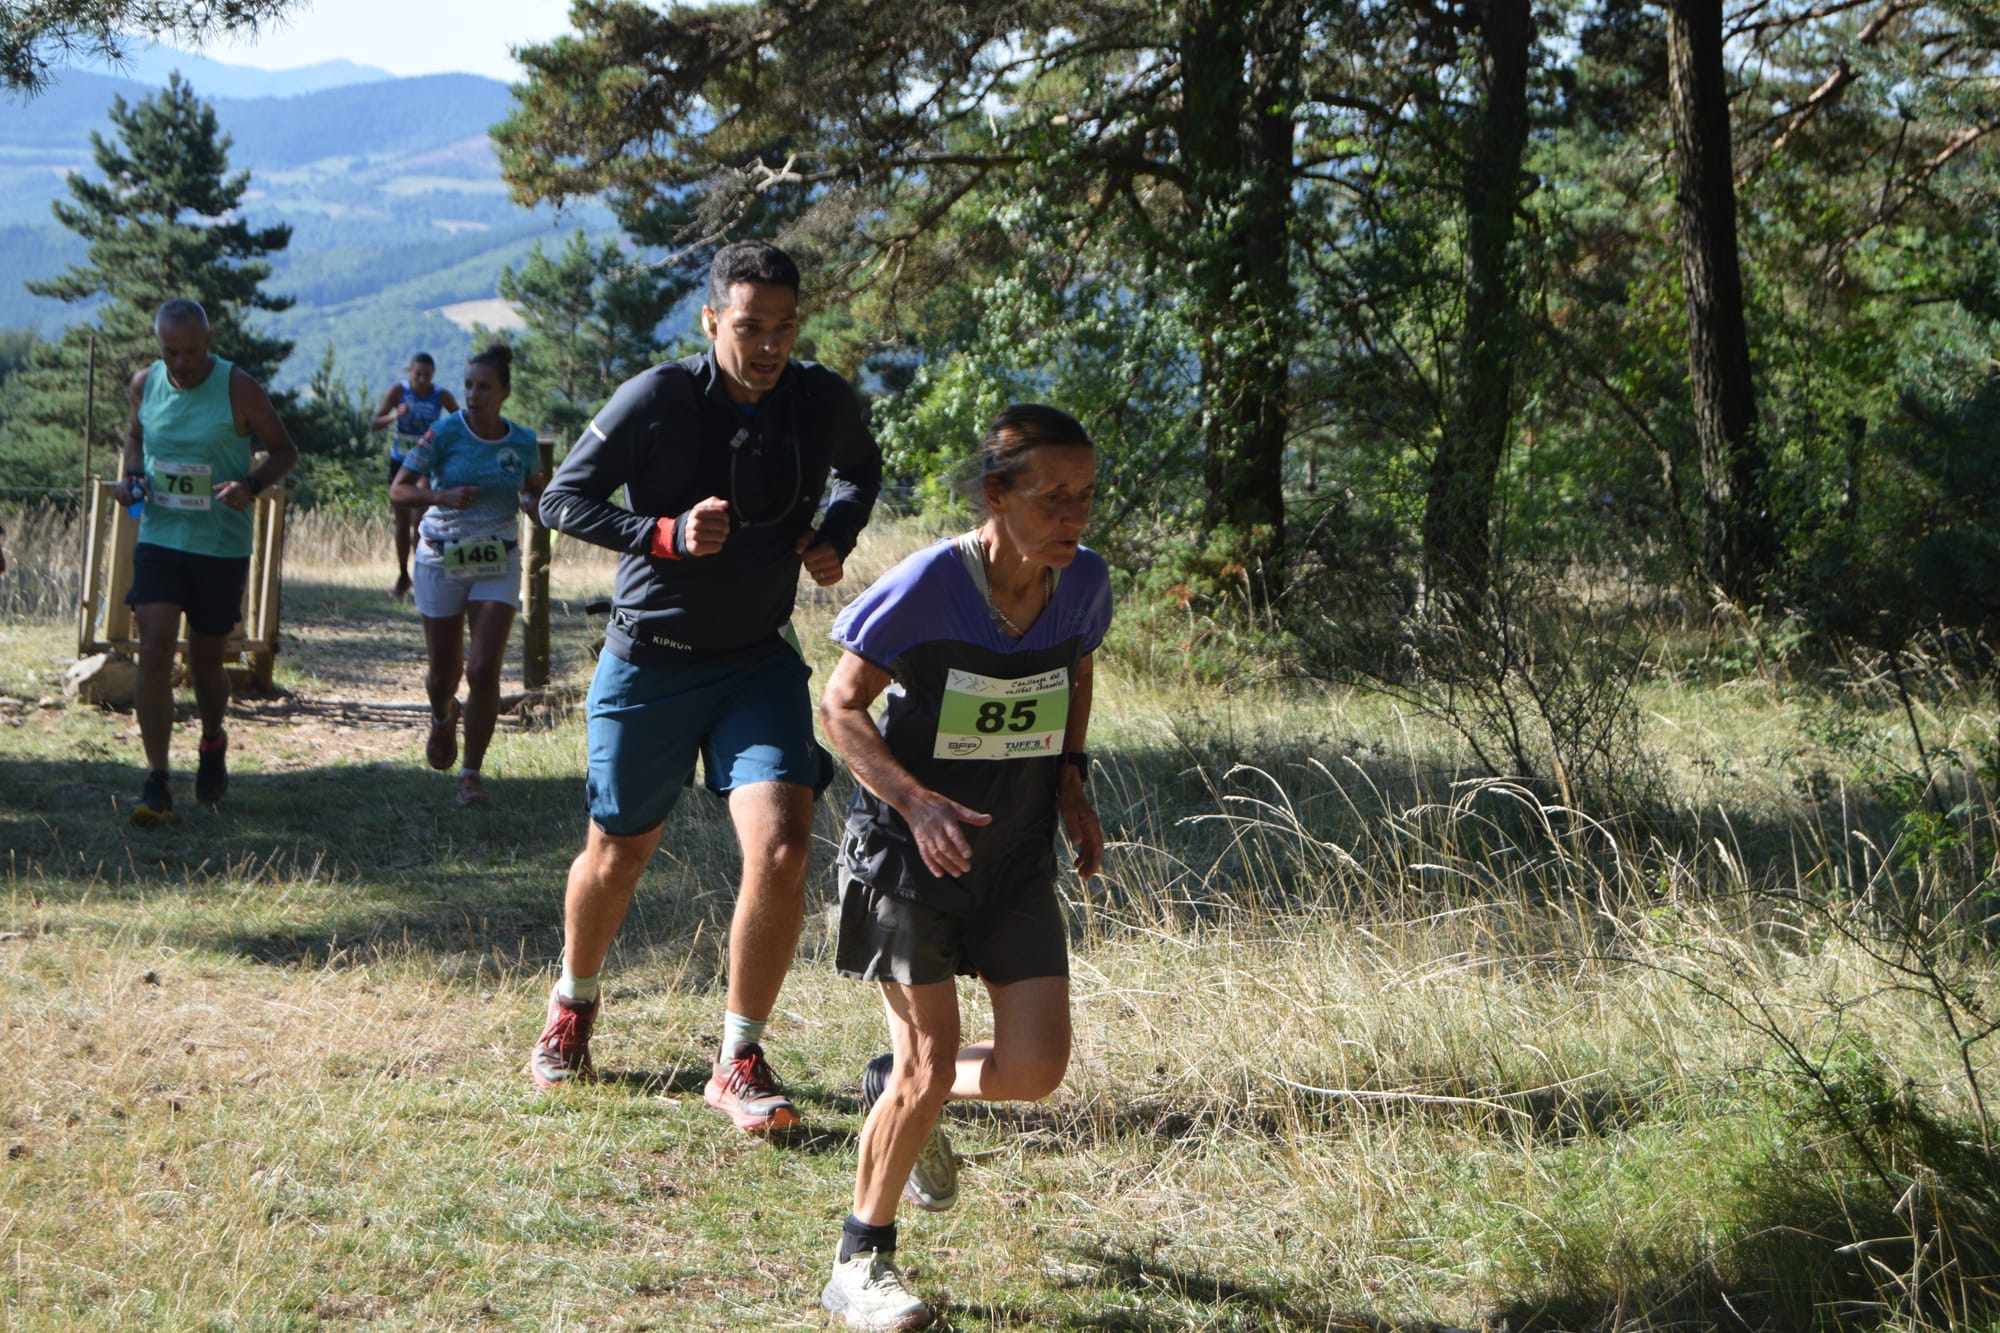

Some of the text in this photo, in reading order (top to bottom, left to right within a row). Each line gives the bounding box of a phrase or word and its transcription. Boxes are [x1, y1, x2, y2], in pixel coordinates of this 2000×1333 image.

[165, 474, 194, 494] 76
[453, 545, 498, 564] 146
[652, 635, 692, 651] KIPRUN
[976, 699, 1038, 734] 85
[1004, 739, 1041, 749] TUFF'S
